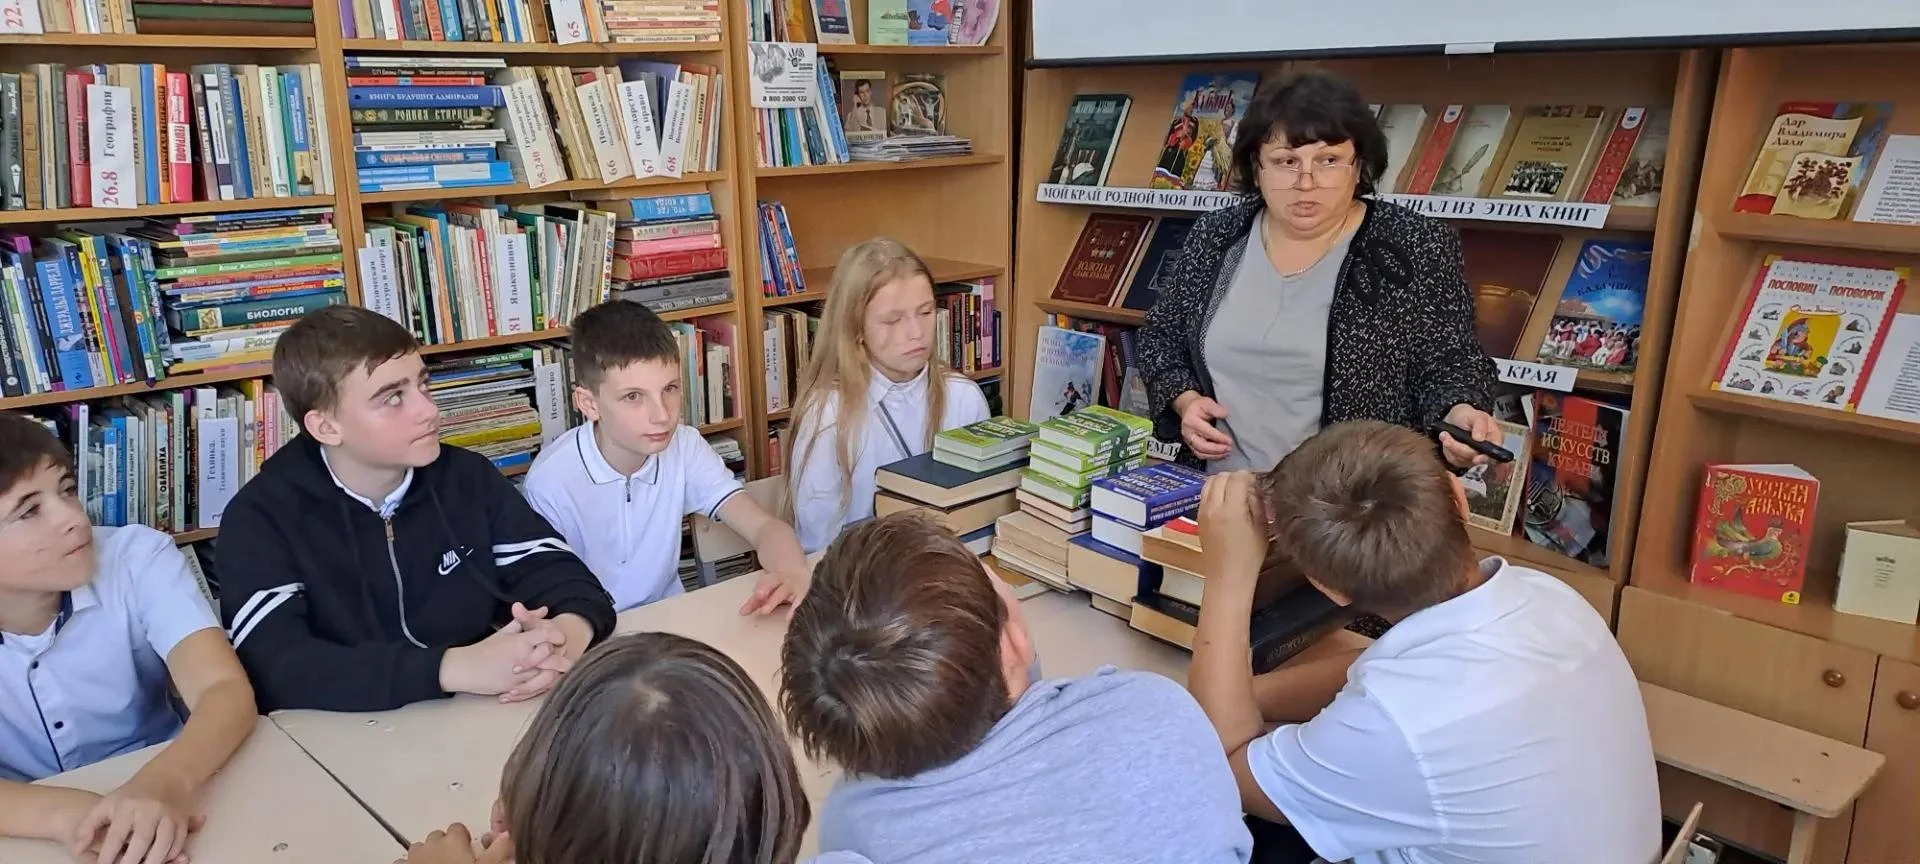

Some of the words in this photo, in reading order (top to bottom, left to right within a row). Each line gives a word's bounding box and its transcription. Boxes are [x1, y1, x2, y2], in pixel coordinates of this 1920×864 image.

[3, 0, 23, 28] 22.
[567, 21, 582, 38] 65
[220, 66, 234, 116] ГЕОГРАФИЯ
[264, 73, 275, 109] ГЕОГРАФИЯ
[369, 93, 395, 101] КНИГА
[397, 93, 434, 102] БУДУЩИХ
[435, 93, 479, 101] АДМИРАЛОВ
[587, 92, 606, 145] Политика.
[625, 86, 644, 147] Государство
[638, 93, 651, 123] право
[102, 91, 117, 158] География
[1777, 127, 1847, 140] Владимира
[1780, 117, 1806, 128] Дар
[174, 124, 187, 162] ГЕОГРАФИЯ
[532, 151, 548, 184] 65.240
[606, 159, 618, 176] 66
[642, 158, 655, 174] 67
[666, 156, 677, 173] 68
[101, 170, 119, 206] 26.8
[1043, 186, 1068, 199] МОЙ
[1070, 187, 1102, 201] КРАЙ
[1105, 189, 1155, 205] РОДНОЙ
[1156, 192, 1187, 206] МОЯ
[1192, 194, 1240, 208] ИСТОР
[1452, 202, 1475, 214] ИЗ
[1482, 202, 1535, 218] ЭТИХ
[1538, 205, 1597, 222] КНИГ
[377, 248, 389, 273] спорт
[506, 238, 519, 305] Языкознание
[1075, 262, 1115, 273] ЗОЛОТАЯ
[44, 262, 64, 295] ДАРРЕЛЛ
[369, 260, 382, 312] Физическая
[1768, 279, 1818, 295] ПОСЛОВИЦ
[1829, 285, 1886, 301] ПОГОВОРОК
[53, 295, 74, 334] ДЖЕРАЛЬД
[247, 306, 305, 320] БИОЛОГИЯ
[380, 282, 393, 319] ультура
[508, 317, 521, 331] 81
[1506, 366, 1558, 384] КРАЯ
[1548, 416, 1609, 446] ДЕЯТЕЛИ
[207, 439, 217, 481] Техника.
[1541, 432, 1610, 465] ИСКУССТВ
[158, 446, 168, 493] ОБЛЕПИХА
[1548, 453, 1600, 479] КУБАНИ
[1746, 498, 1805, 525] АЗБУКА
[443, 550, 460, 568] NIK
